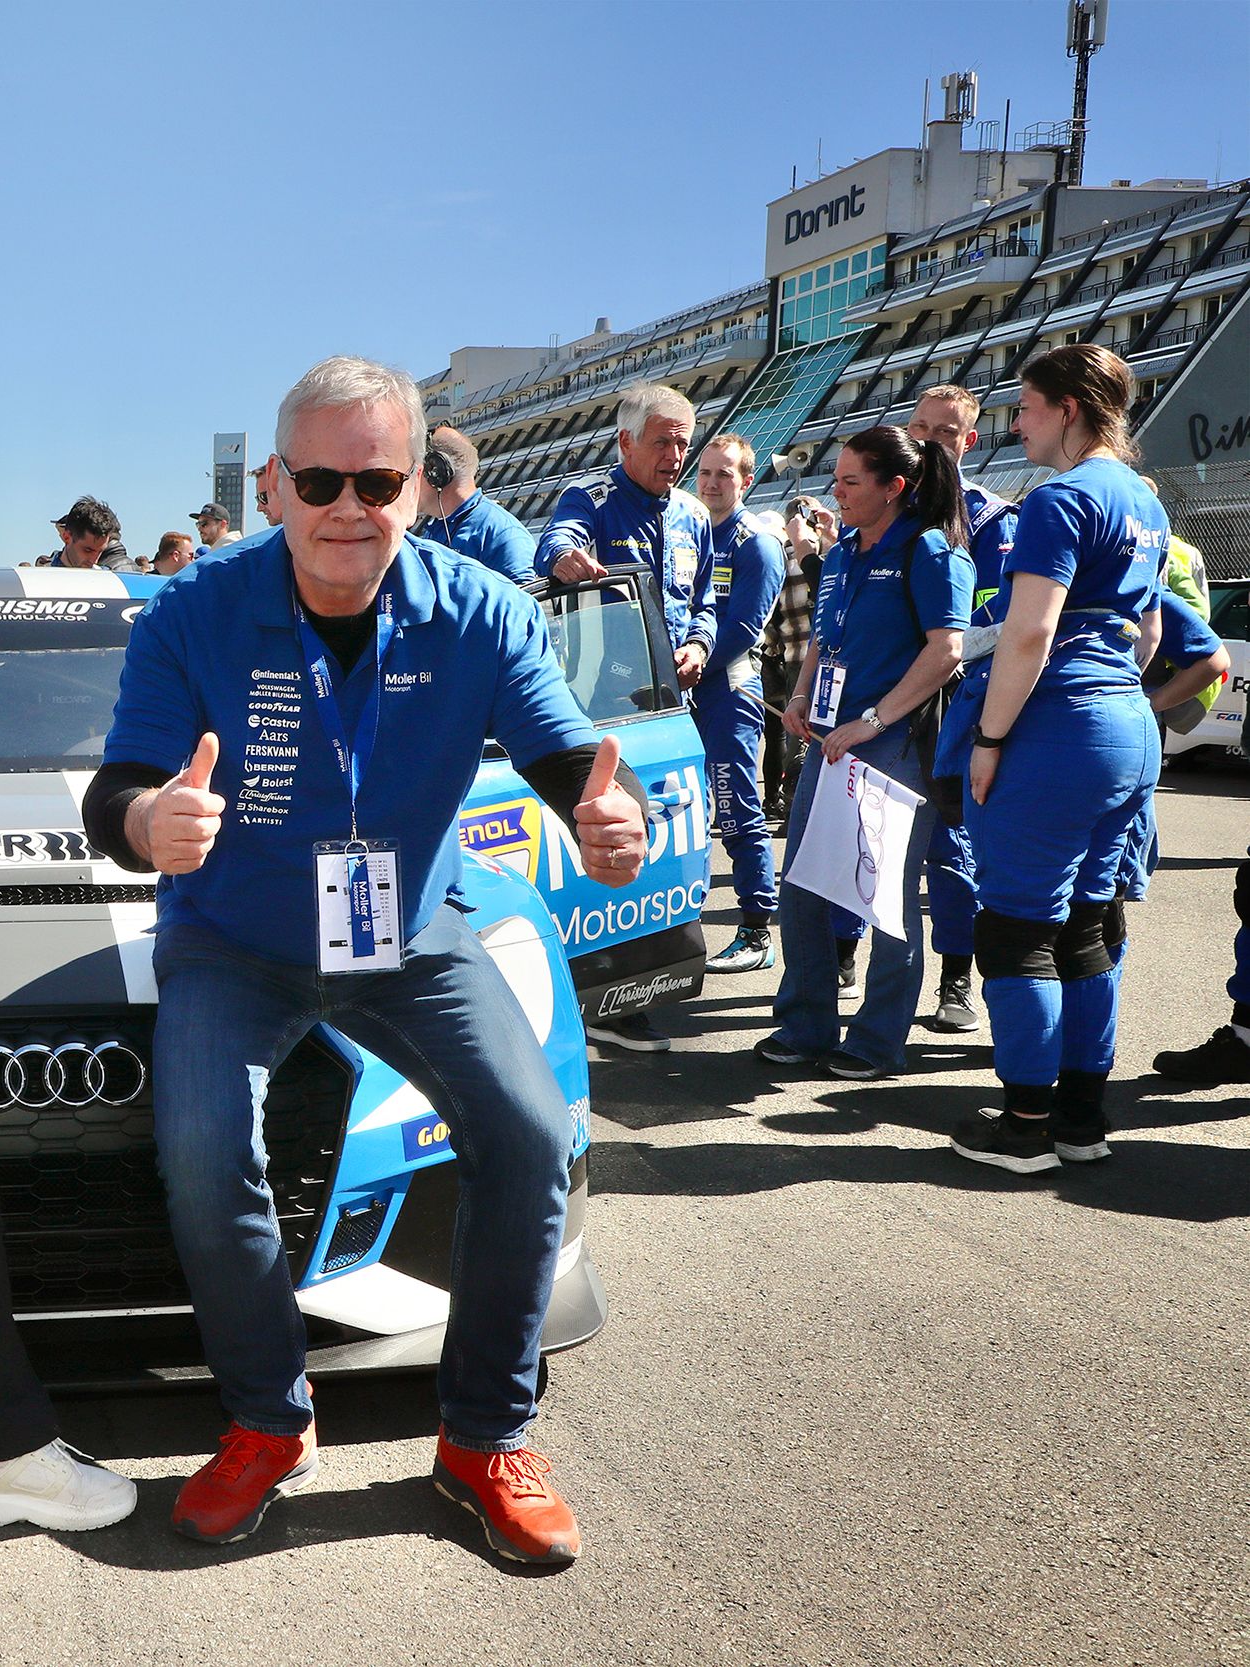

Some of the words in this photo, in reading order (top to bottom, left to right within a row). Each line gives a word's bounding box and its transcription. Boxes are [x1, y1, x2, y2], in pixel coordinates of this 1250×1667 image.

[785, 184, 865, 245] Dorint
[251, 669, 295, 681] Continental
[419, 671, 432, 684] Bil
[248, 702, 301, 713] GOODYEAR
[261, 717, 300, 729] Castrol
[259, 728, 289, 742] Aars
[245, 744, 299, 757] FERSKVANN
[253, 763, 297, 772] BERNER
[261, 777, 293, 788] Bolest
[716, 762, 734, 815] Moller
[247, 803, 289, 815] Sharebox
[251, 817, 283, 825] ARTISTI
